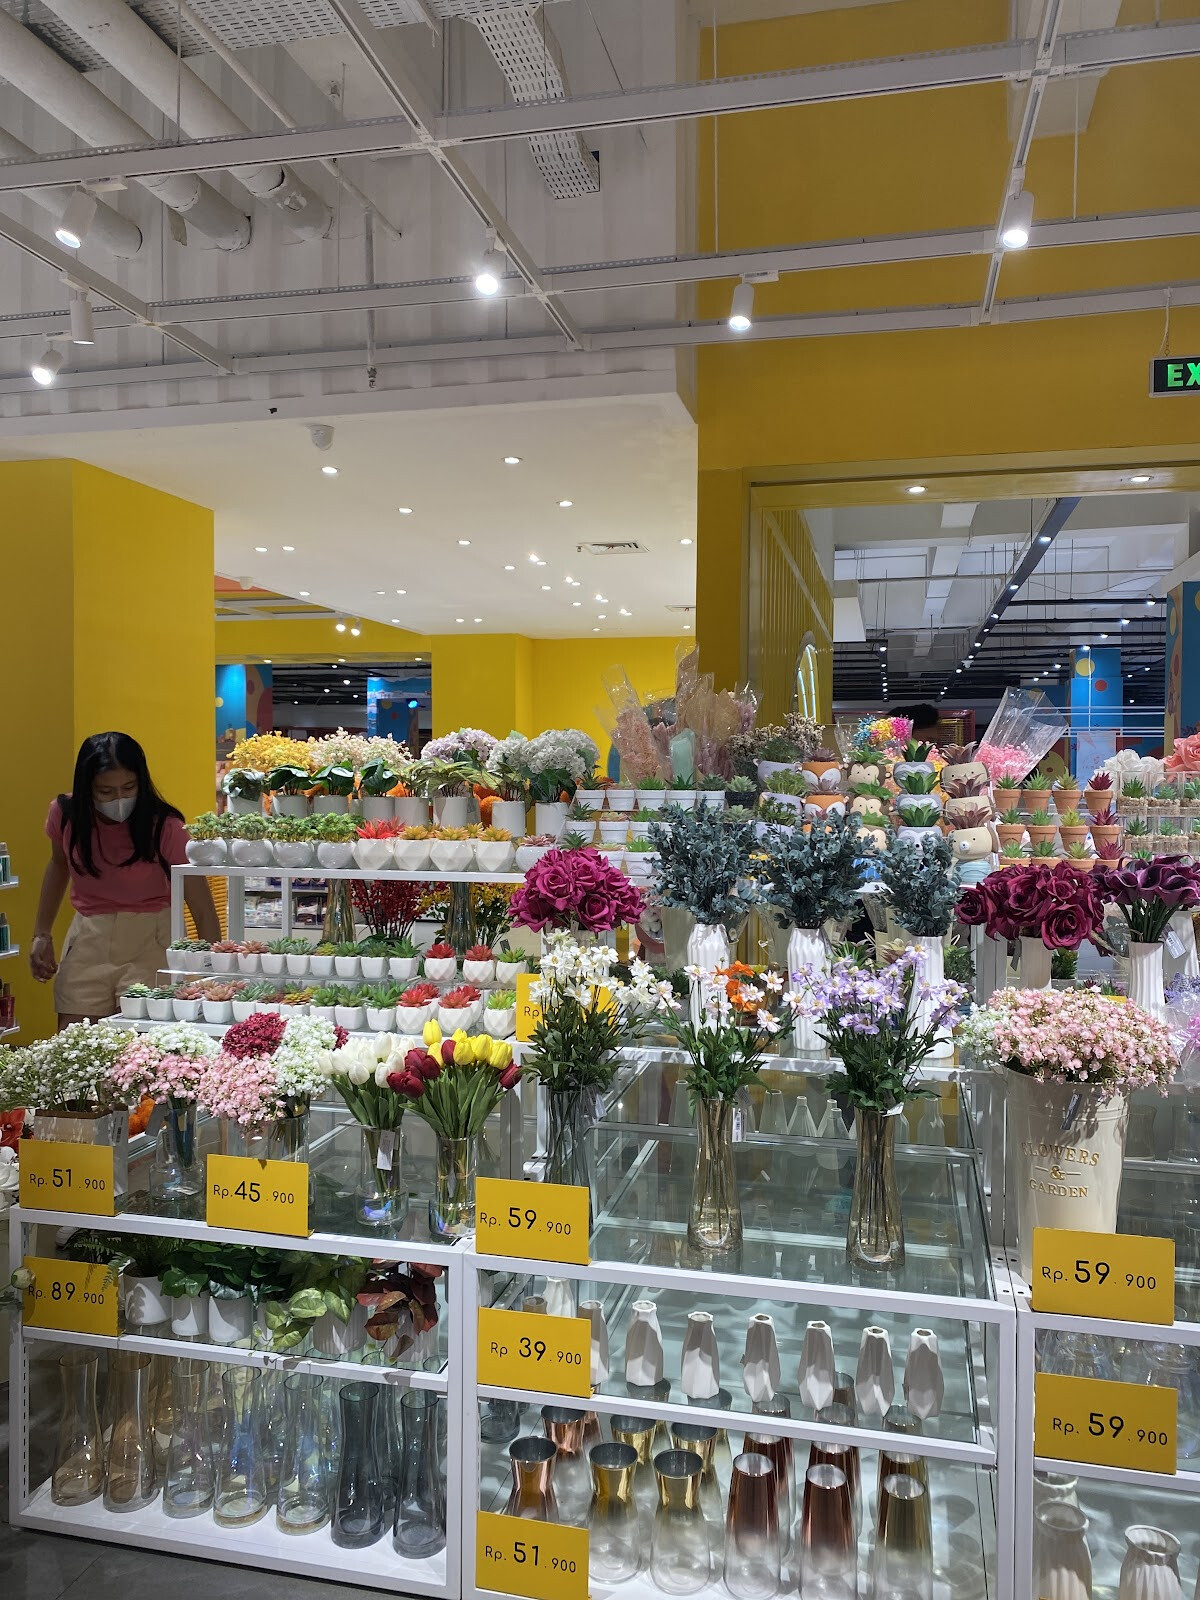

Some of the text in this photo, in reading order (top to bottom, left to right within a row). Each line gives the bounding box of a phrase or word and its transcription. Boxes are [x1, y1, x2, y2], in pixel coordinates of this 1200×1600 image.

[29, 1173, 48, 1187] Rp.
[1050, 1164, 1066, 1180] &
[213, 1184, 233, 1199] Rp.
[1029, 1178, 1088, 1198] GARDEN
[480, 1211, 501, 1228] Rp.
[1041, 1266, 1068, 1283] Rp.
[28, 1285, 47, 1300] Rp.
[490, 1341, 508, 1358] Rp
[1052, 1417, 1079, 1435] Rp.
[485, 1545, 507, 1562] Rp.
